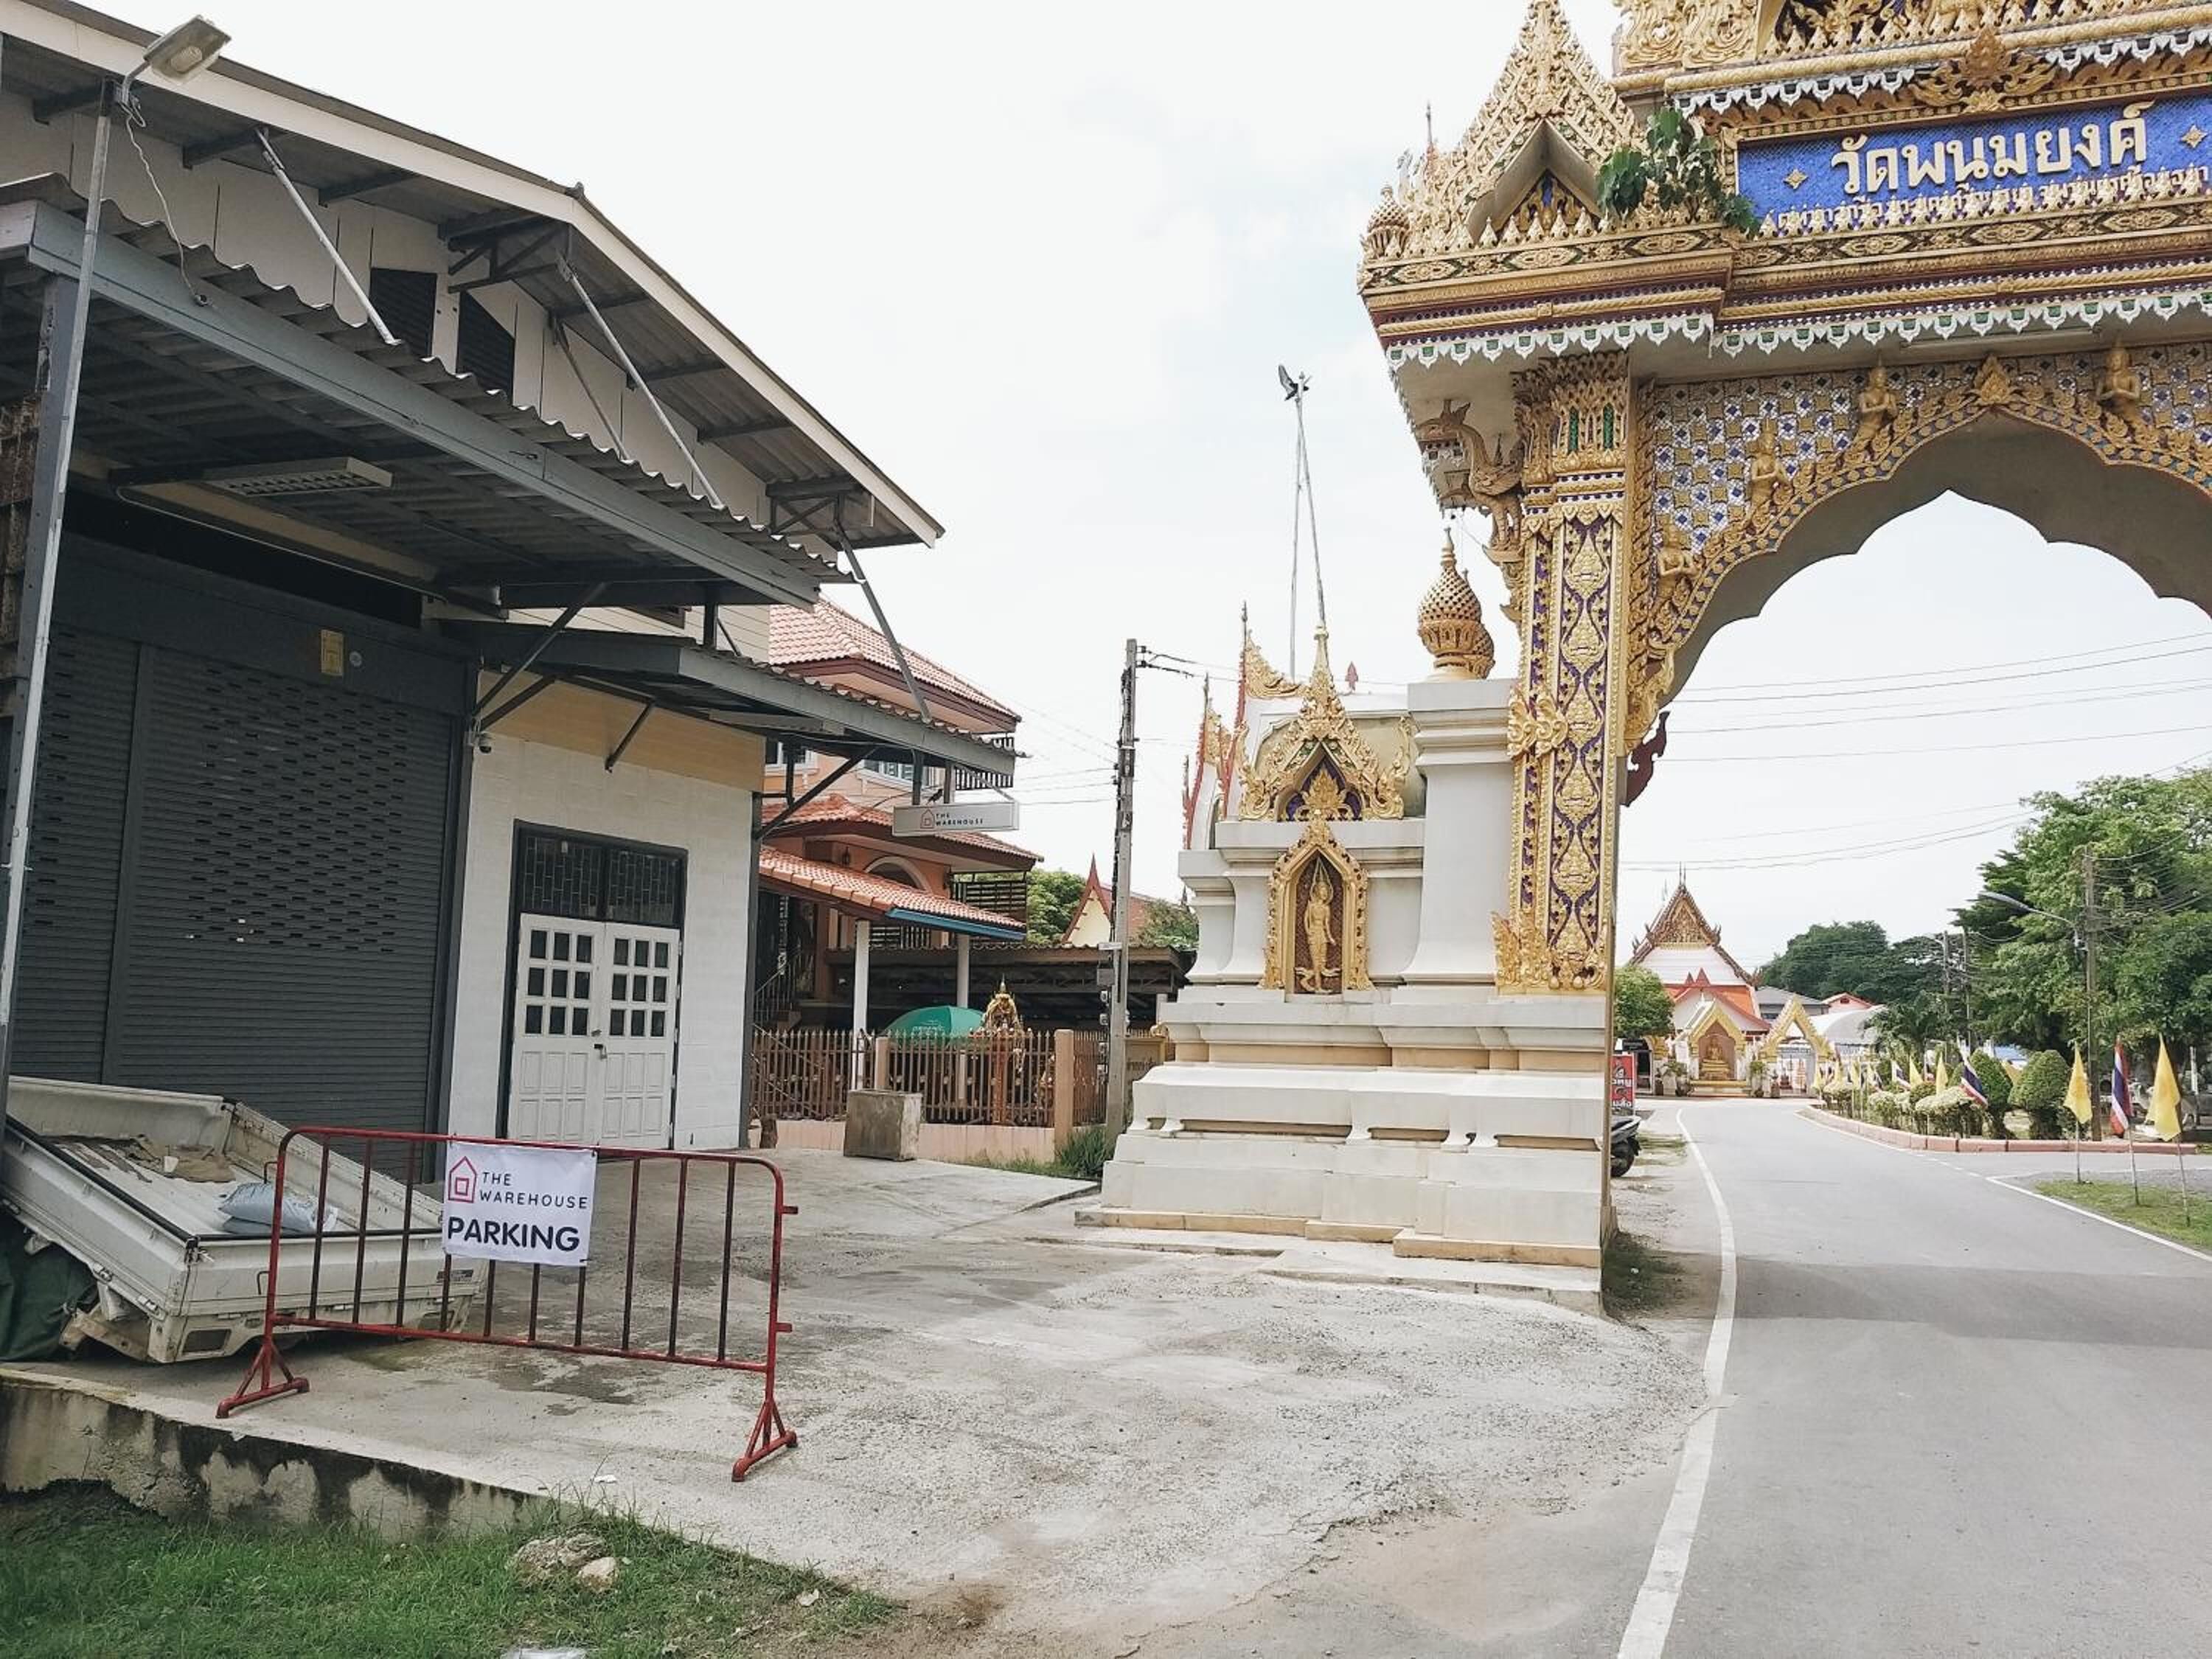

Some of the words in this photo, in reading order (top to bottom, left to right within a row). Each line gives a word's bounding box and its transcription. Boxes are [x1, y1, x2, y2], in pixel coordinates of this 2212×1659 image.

[1832, 100, 2155, 195] วัดพนมยงค์
[482, 1172, 512, 1186] THE
[479, 1189, 589, 1209] WAREHOUSE
[448, 1216, 580, 1252] PARKING
